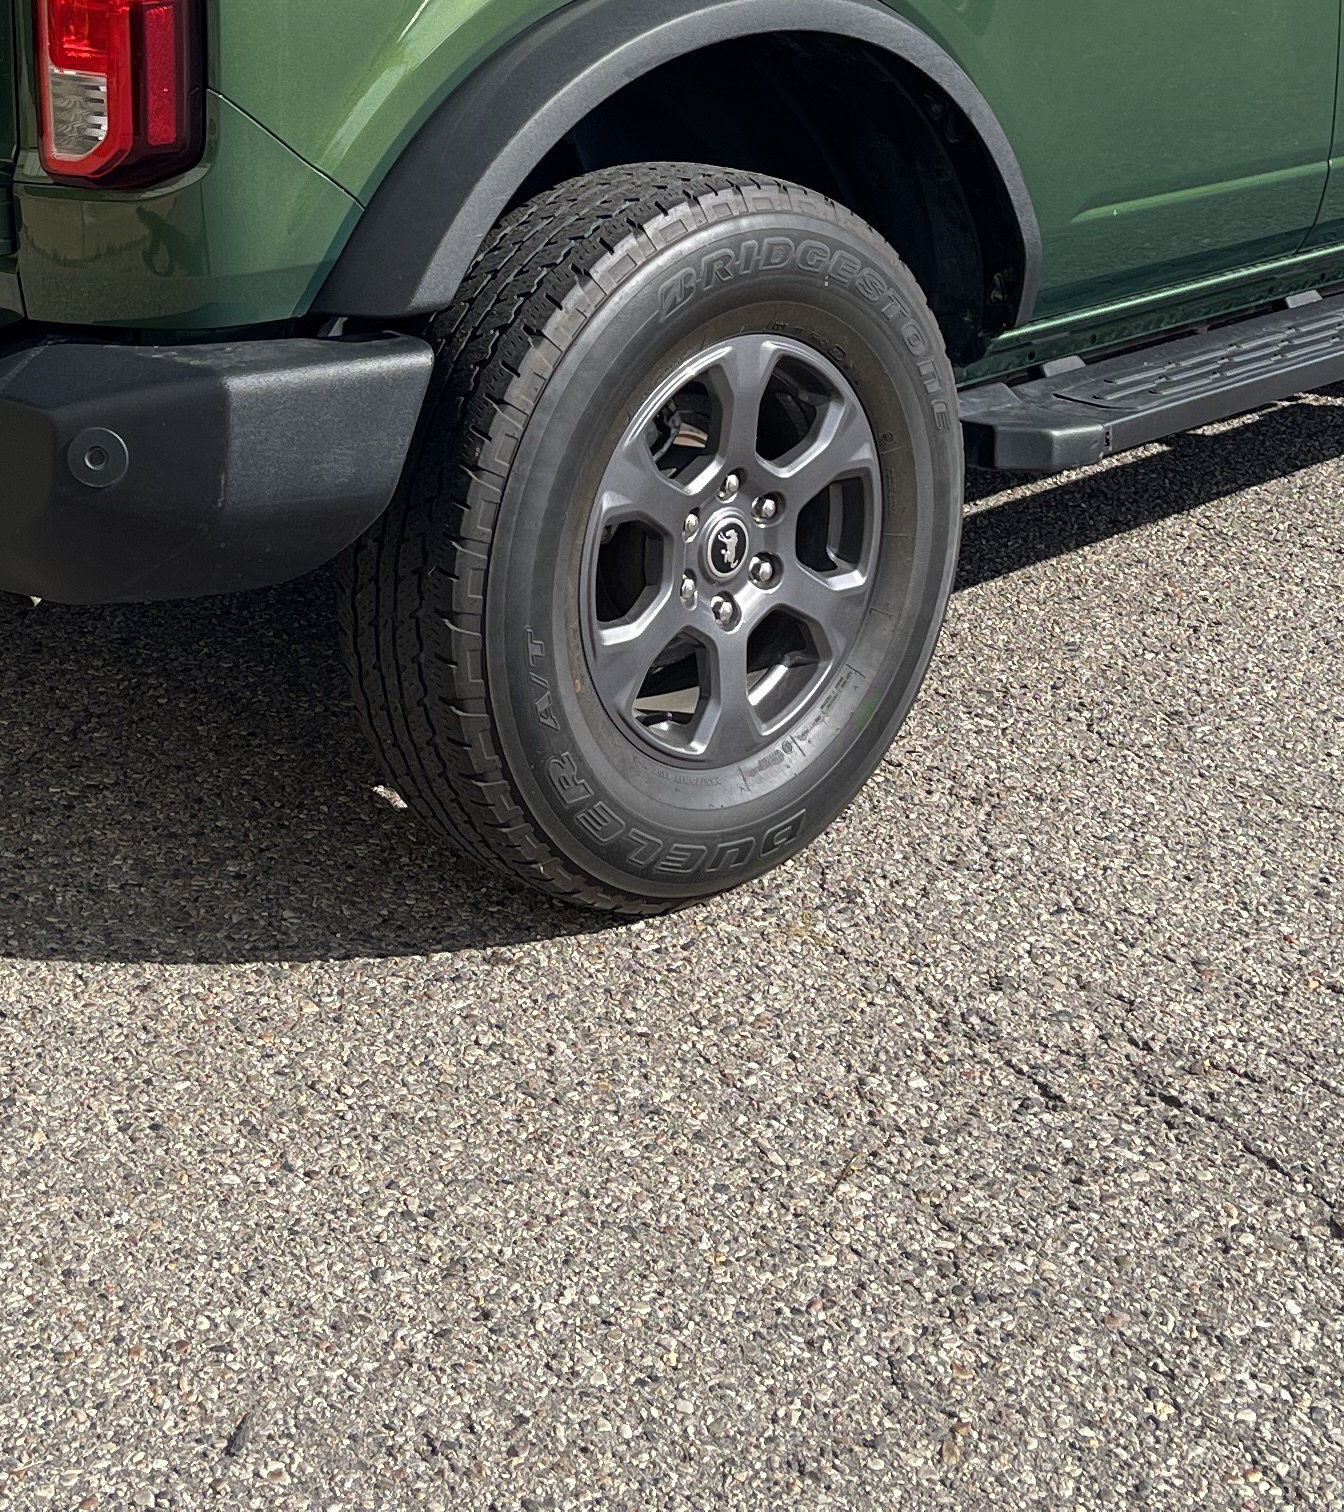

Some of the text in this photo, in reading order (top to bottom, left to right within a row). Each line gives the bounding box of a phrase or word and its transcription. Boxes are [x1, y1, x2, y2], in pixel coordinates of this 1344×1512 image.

[658, 236, 953, 432] BRIDGESTONE
[524, 624, 808, 874] DUELER A/T
